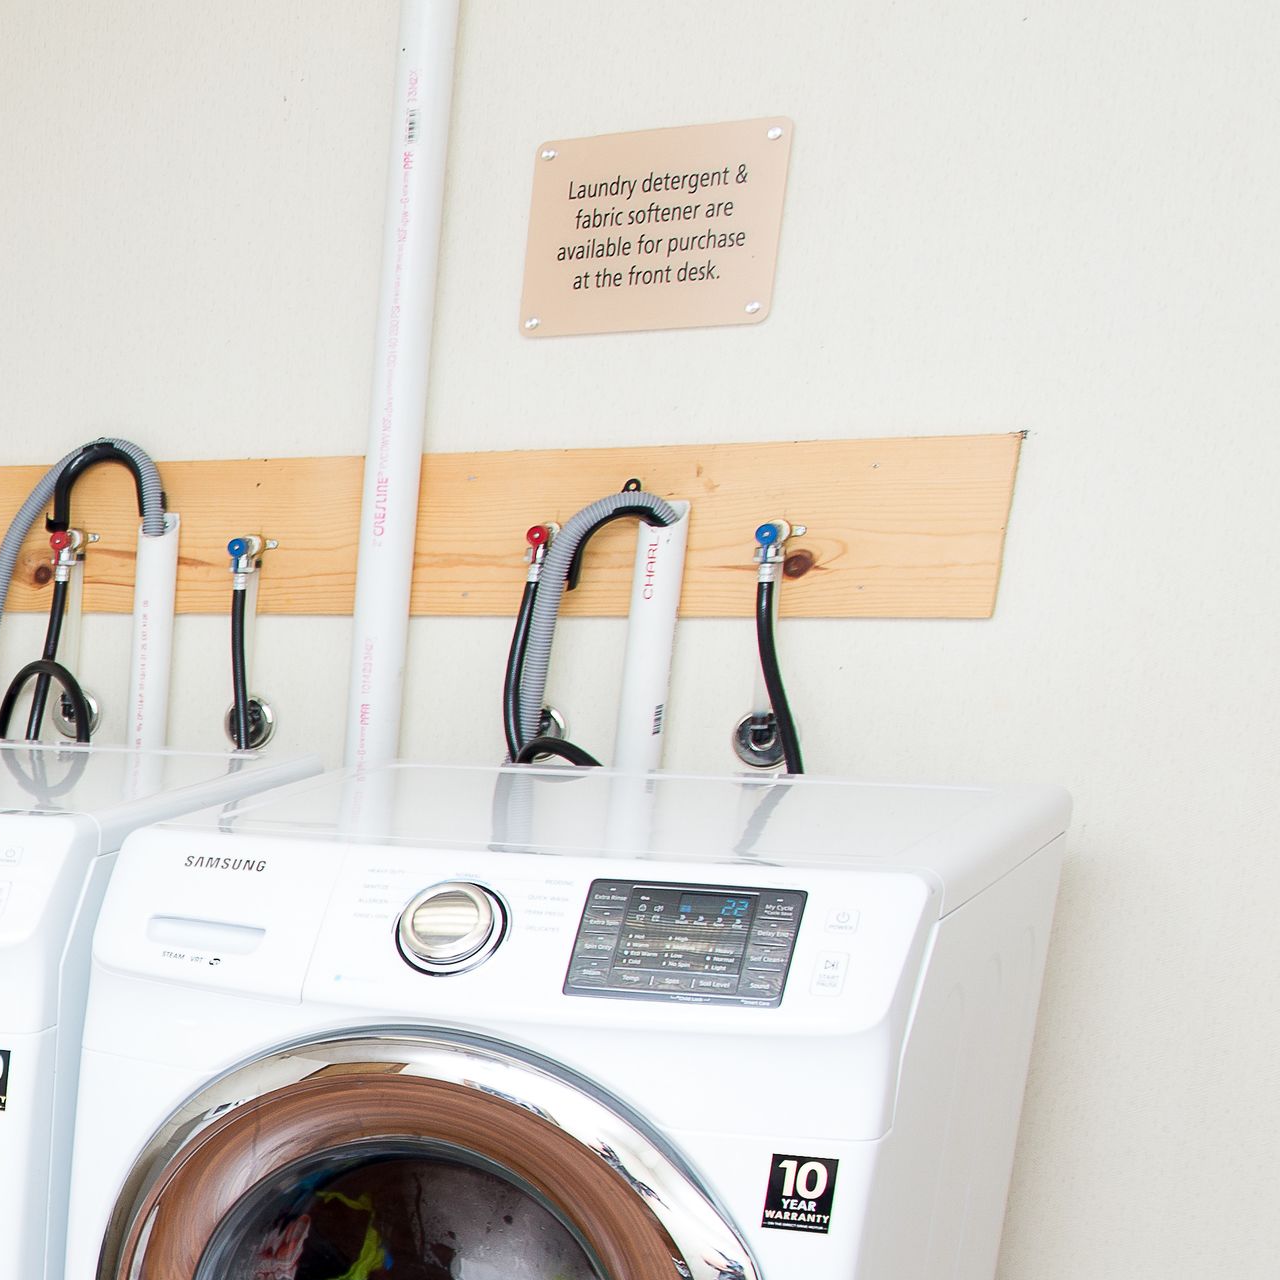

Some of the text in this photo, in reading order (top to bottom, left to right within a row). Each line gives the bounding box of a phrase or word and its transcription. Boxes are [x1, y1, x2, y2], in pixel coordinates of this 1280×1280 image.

[568, 163, 748, 200] Laundry detergent &
[575, 200, 734, 230] fabric softener are
[557, 228, 746, 261] available for purchase
[572, 259, 721, 290] at the front desk.
[642, 531, 660, 600] CHARL
[184, 855, 267, 873] SAMSUNG
[720, 899, 749, 917] 22
[757, 930, 776, 938] Delay
[778, 1160, 828, 1199] 10
[765, 1210, 829, 1223] WARRANTY
[781, 1198, 817, 1212] YEAR
